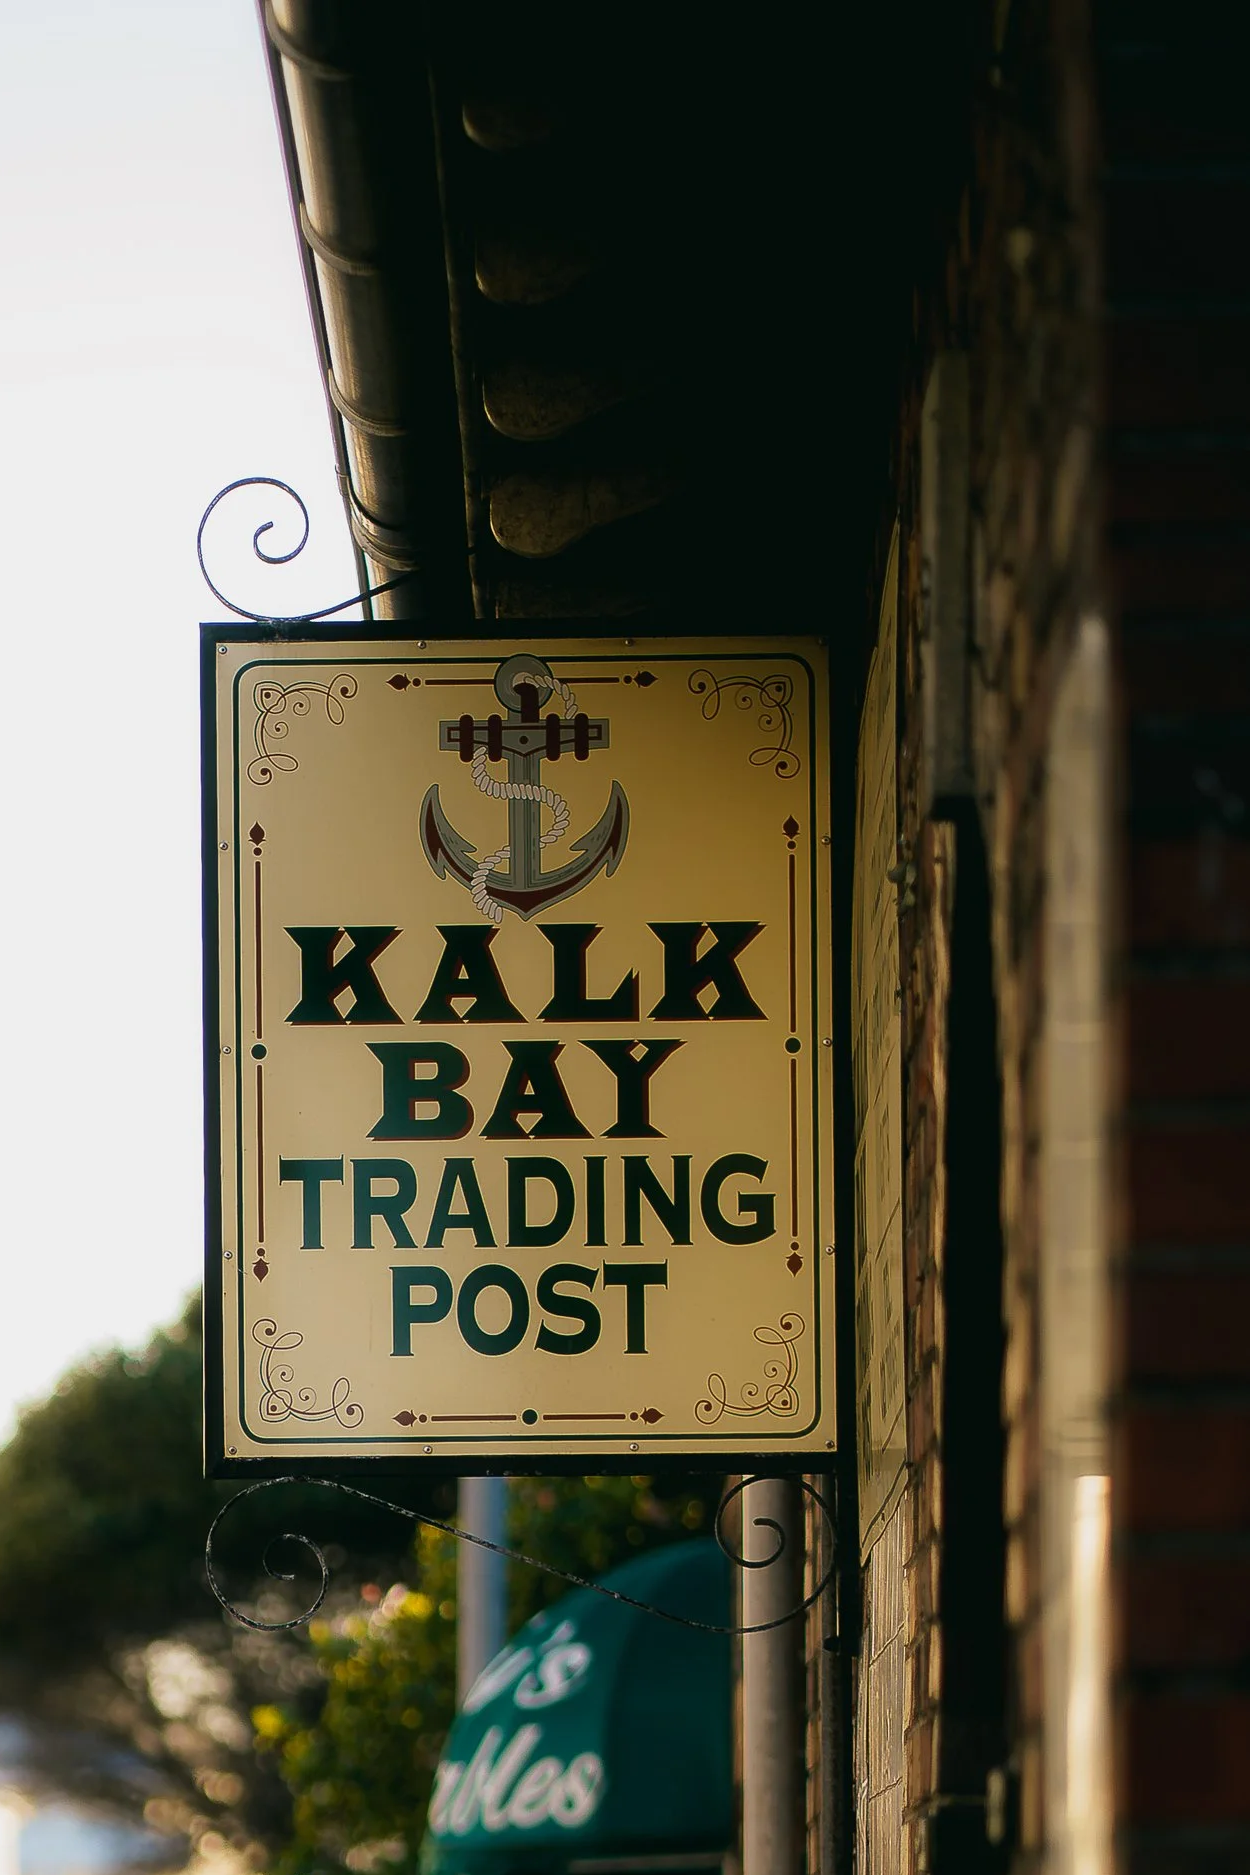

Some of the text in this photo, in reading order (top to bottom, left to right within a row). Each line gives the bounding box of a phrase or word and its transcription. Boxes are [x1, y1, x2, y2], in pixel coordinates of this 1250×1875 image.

[284, 921, 768, 1025] KALK
[364, 1038, 687, 1141] BAY
[279, 1153, 777, 1250] TRADING
[390, 1259, 668, 1357] POST
